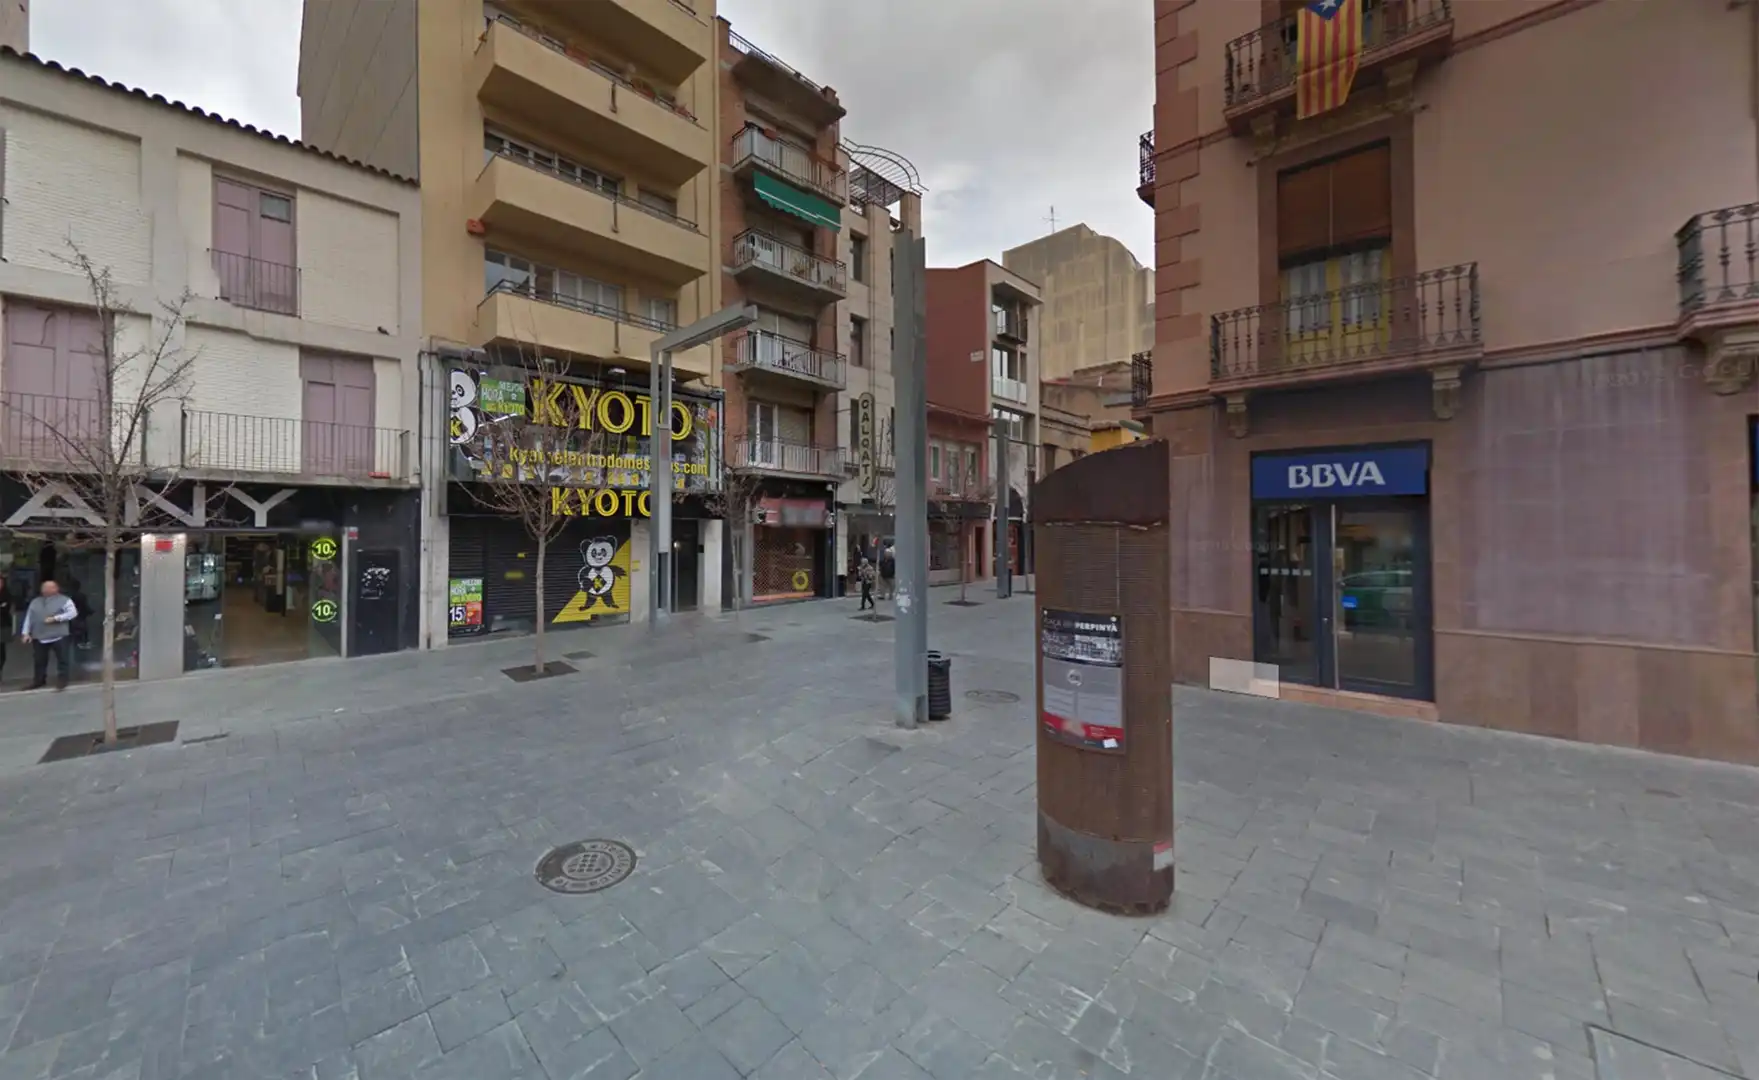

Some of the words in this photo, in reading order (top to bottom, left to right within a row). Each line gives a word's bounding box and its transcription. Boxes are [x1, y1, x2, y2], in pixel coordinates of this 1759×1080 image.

[532, 379, 693, 440] KYOTO
[1288, 461, 1386, 489] BBVA
[552, 487, 651, 516] KYOTO
[1075, 622, 1118, 632] PERPINYÀ
